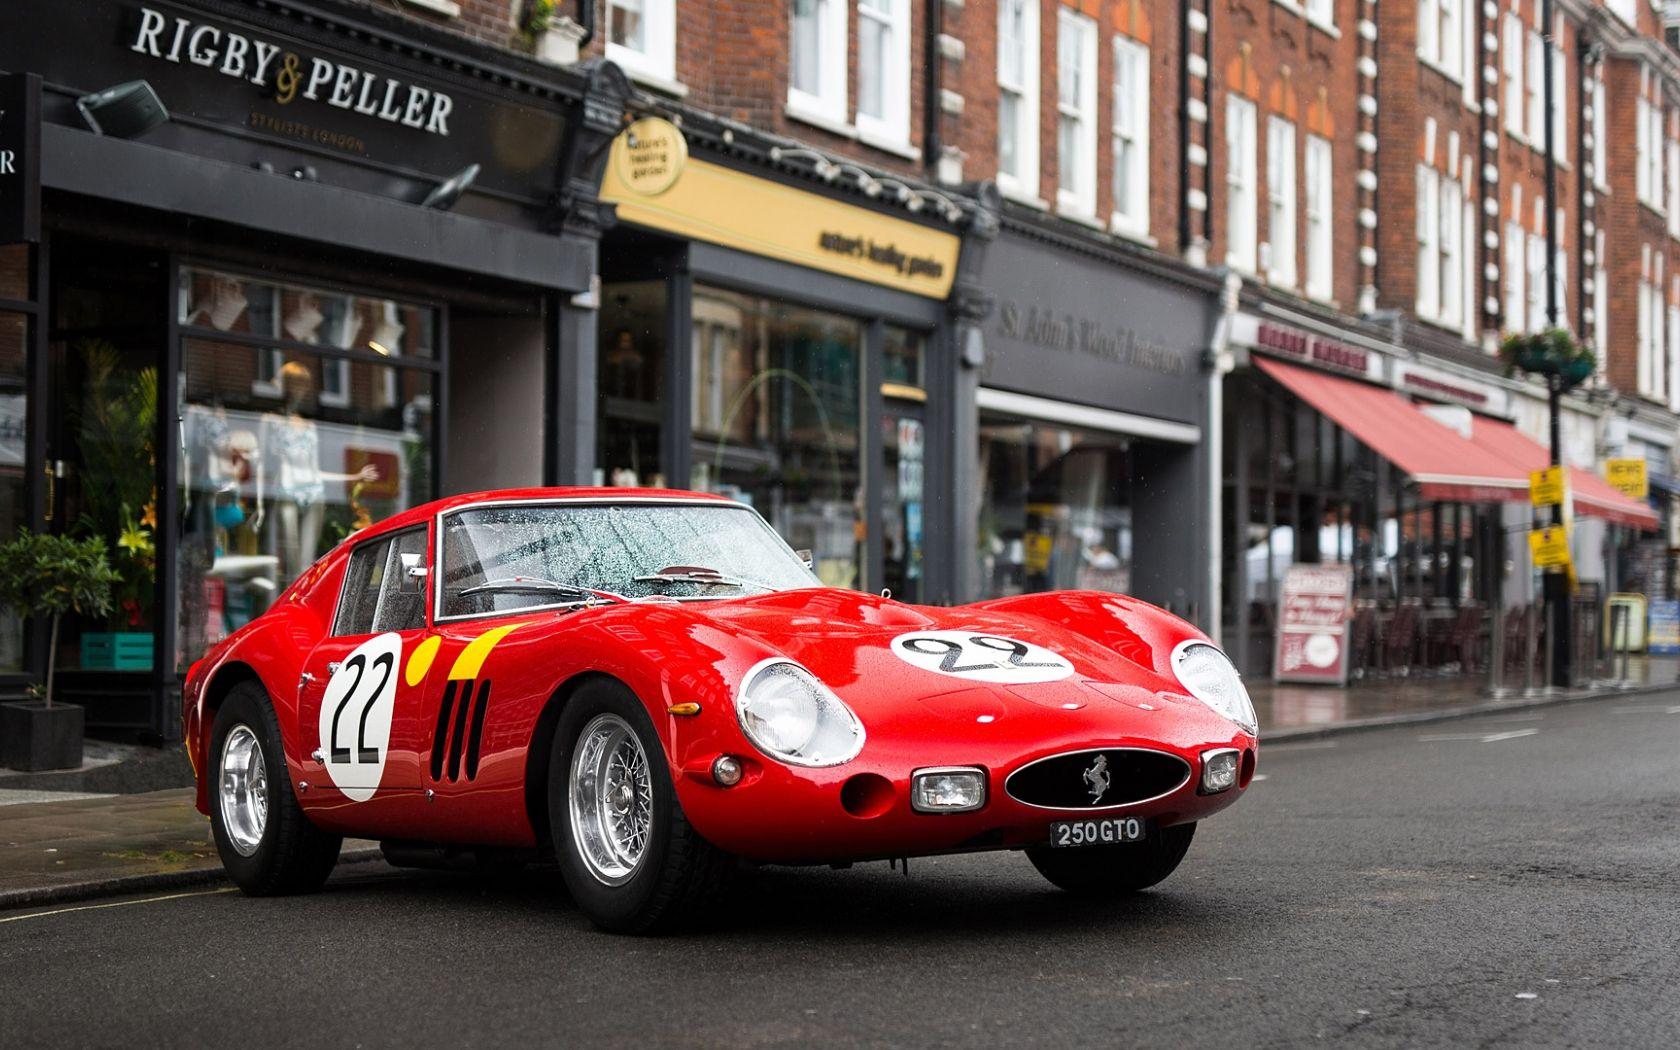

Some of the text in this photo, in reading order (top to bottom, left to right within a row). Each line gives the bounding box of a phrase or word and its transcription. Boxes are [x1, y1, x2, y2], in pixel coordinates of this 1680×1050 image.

[131, 8, 453, 136] RIGBY & PELLER
[312, 129, 365, 153] LONDON
[901, 636, 1065, 673] 22
[331, 652, 394, 764] 22
[1058, 818, 1139, 845] 250 GTO
